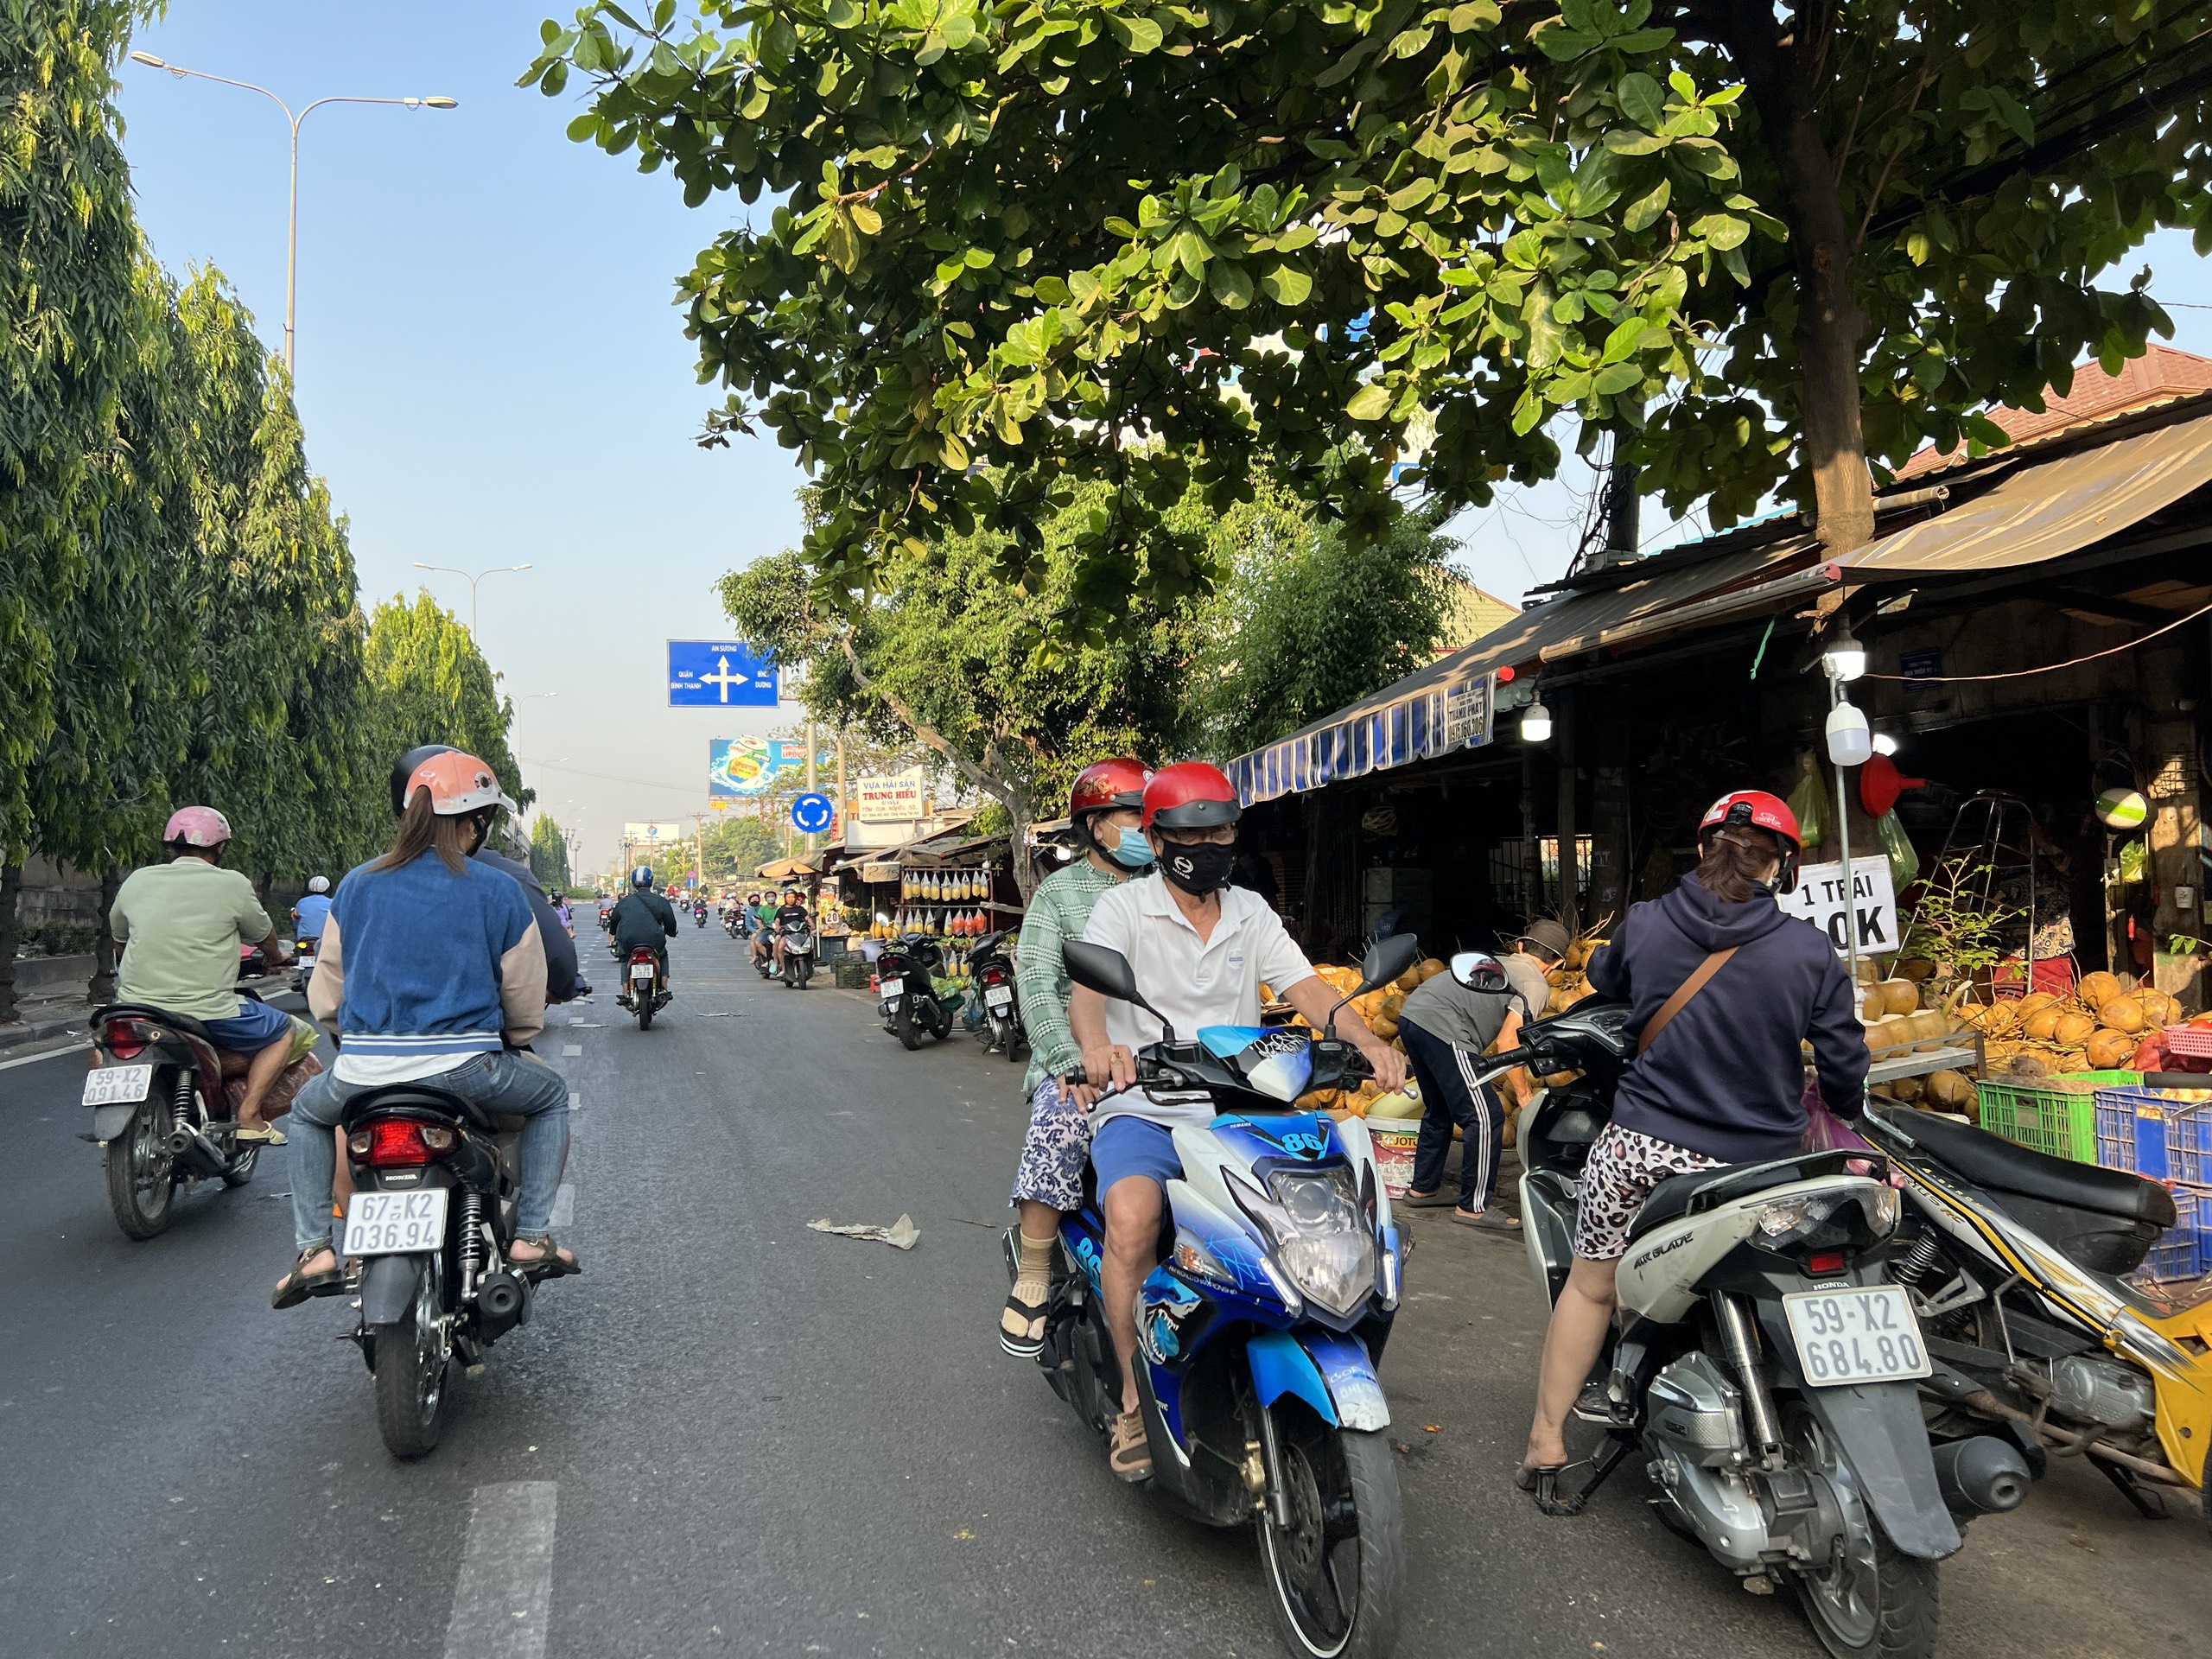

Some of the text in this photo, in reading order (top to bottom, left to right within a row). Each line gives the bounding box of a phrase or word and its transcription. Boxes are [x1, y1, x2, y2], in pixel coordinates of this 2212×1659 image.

[678, 670, 693, 679] QUẬN
[862, 787, 917, 800] TRUNG HIẾU
[863, 779, 915, 791] VỰA HẢI SẢN
[1801, 870, 1874, 906] 1 TRÁI
[827, 912, 838, 923] 20
[1804, 906, 1887, 950] 0K
[96, 1068, 142, 1085] 59-X2
[87, 1084, 143, 1103] 091.46
[1281, 1132, 1325, 1153] 86
[1394, 1137, 1419, 1147] JOTU
[385, 1173, 418, 1182] HONDA
[1902, 1174, 1943, 1207] RIUS
[362, 1192, 433, 1222] 67-K2
[350, 1220, 436, 1251] 036.94
[1652, 1230, 1694, 1260] BLADE
[1812, 1281, 1851, 1291] HONDA
[1807, 1294, 1898, 1336] 59-X2
[1806, 1333, 1922, 1379] 684.80
